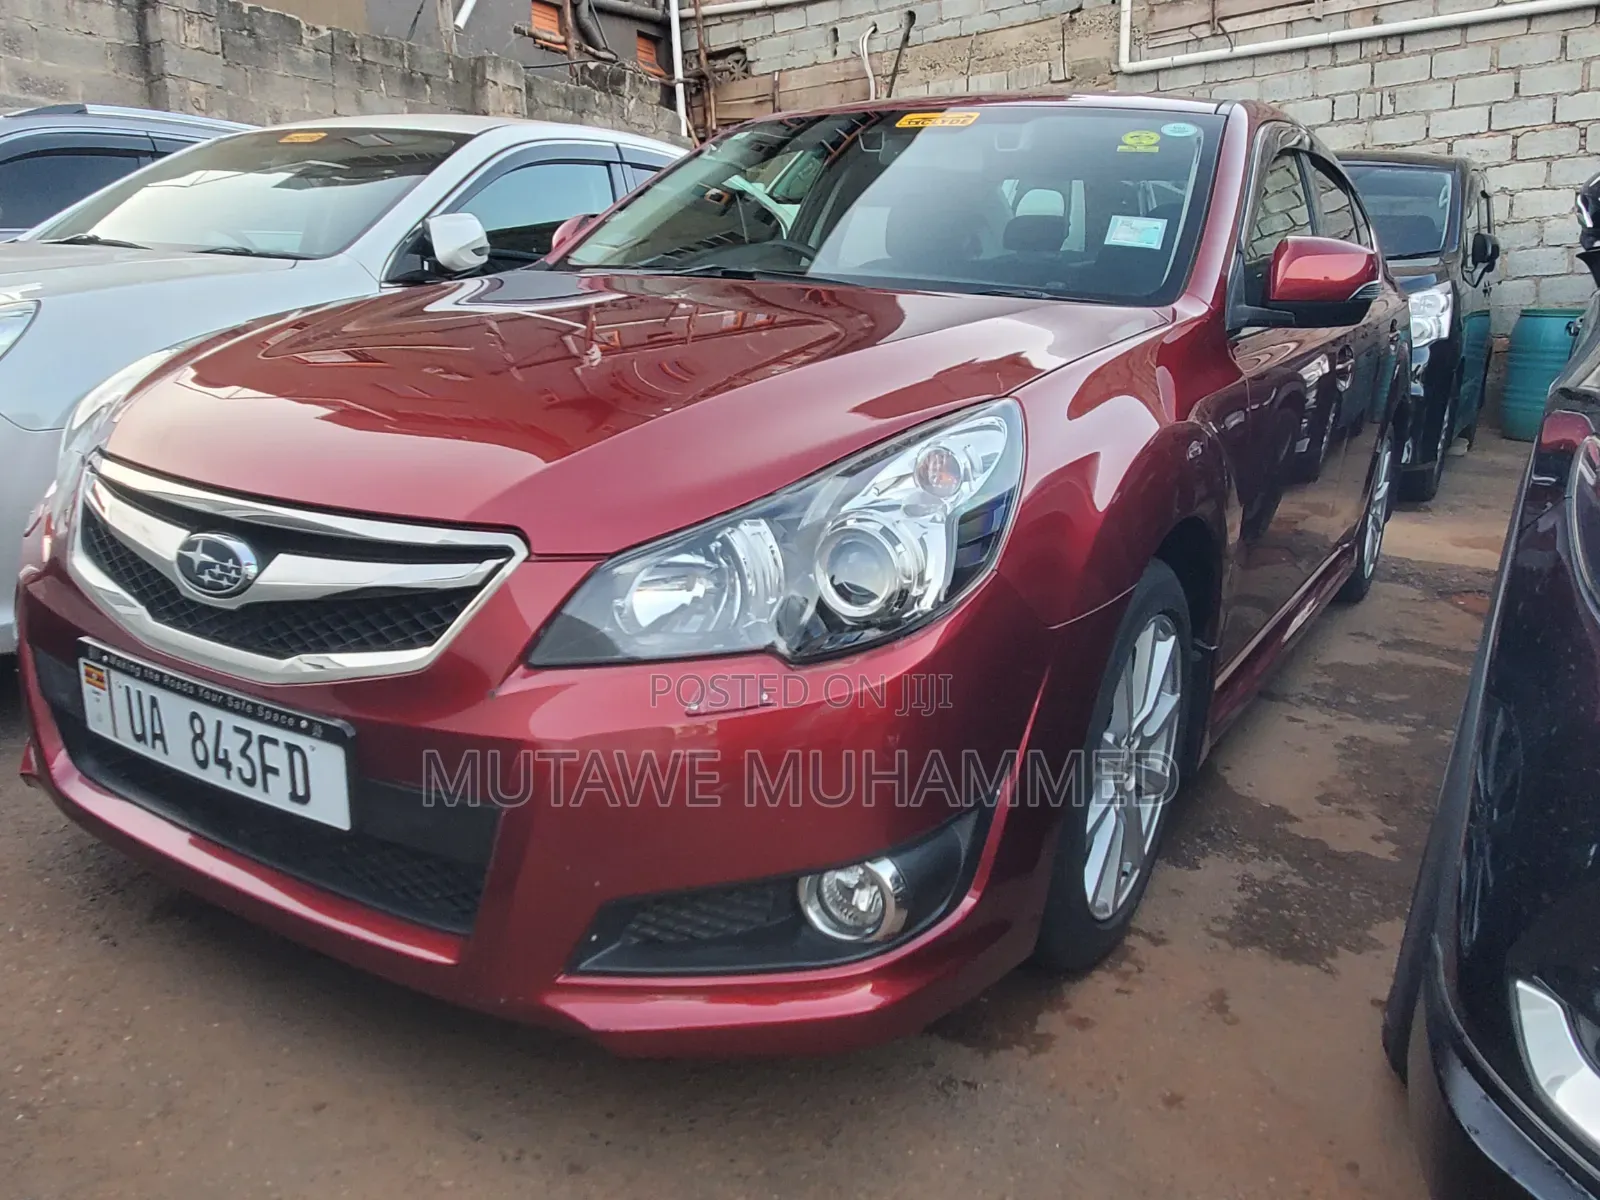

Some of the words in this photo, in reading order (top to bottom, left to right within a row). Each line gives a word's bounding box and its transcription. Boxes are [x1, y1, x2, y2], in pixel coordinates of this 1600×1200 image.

[162, 674, 194, 694] Roads
[198, 686, 223, 703] Your
[227, 696, 253, 714] Safe
[257, 705, 296, 727] Space
[125, 685, 168, 756] UA
[189, 711, 311, 805] 843FD
